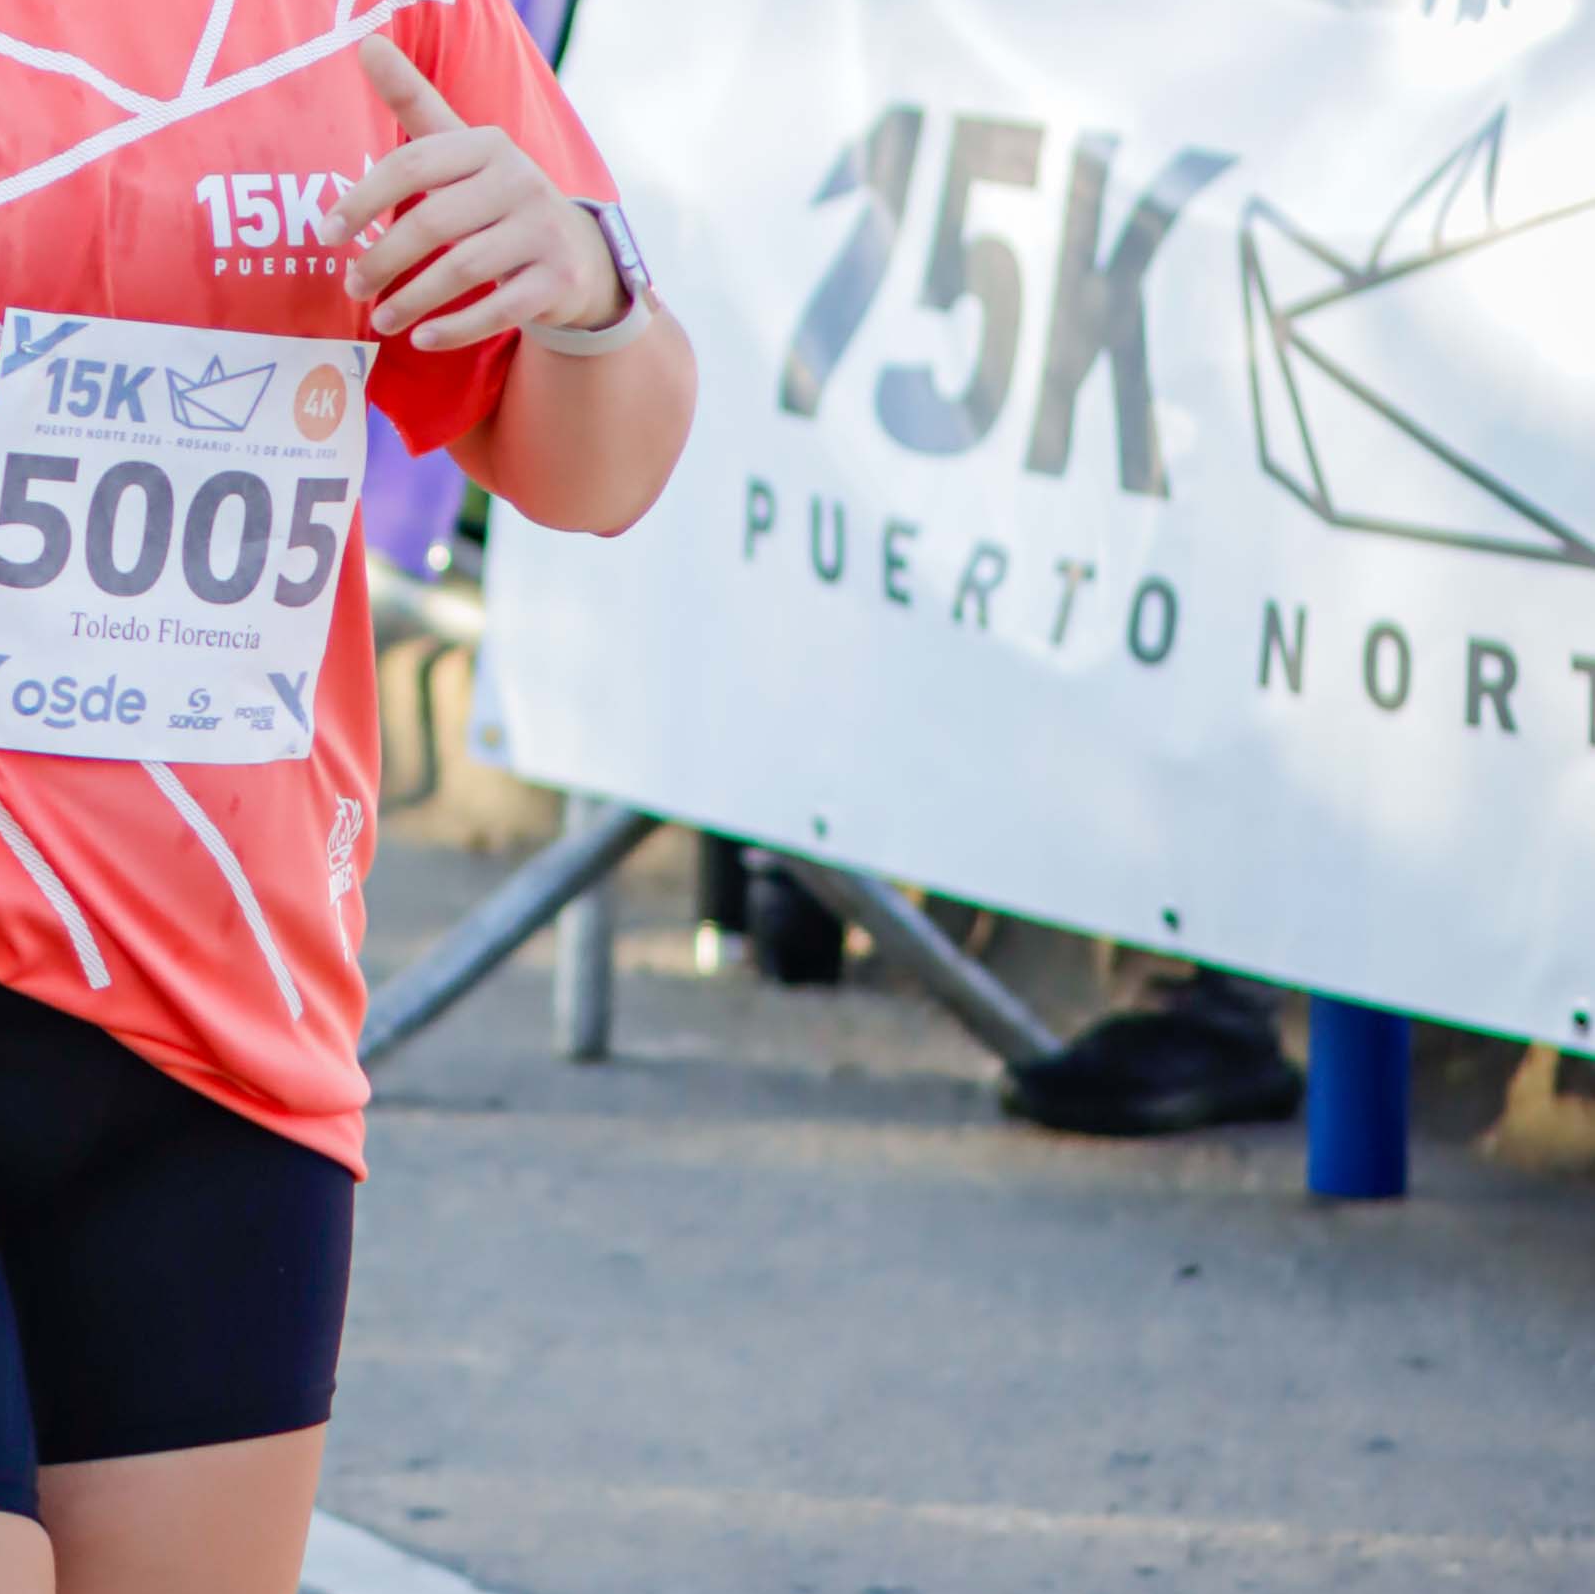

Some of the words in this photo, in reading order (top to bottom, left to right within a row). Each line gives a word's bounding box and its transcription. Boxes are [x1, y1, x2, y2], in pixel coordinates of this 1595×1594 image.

[196, 173, 328, 248] 15K
[214, 257, 336, 276] PUERTO
[778, 102, 1242, 501] 15K
[46, 357, 156, 423] 15K
[302, 388, 340, 420] 4K
[177, 437, 232, 453] ROSARIO
[743, 475, 1180, 667] PUERTO
[70, 611, 150, 642] Toledo
[158, 617, 261, 649] Florencia
[12, 674, 148, 729] osde
